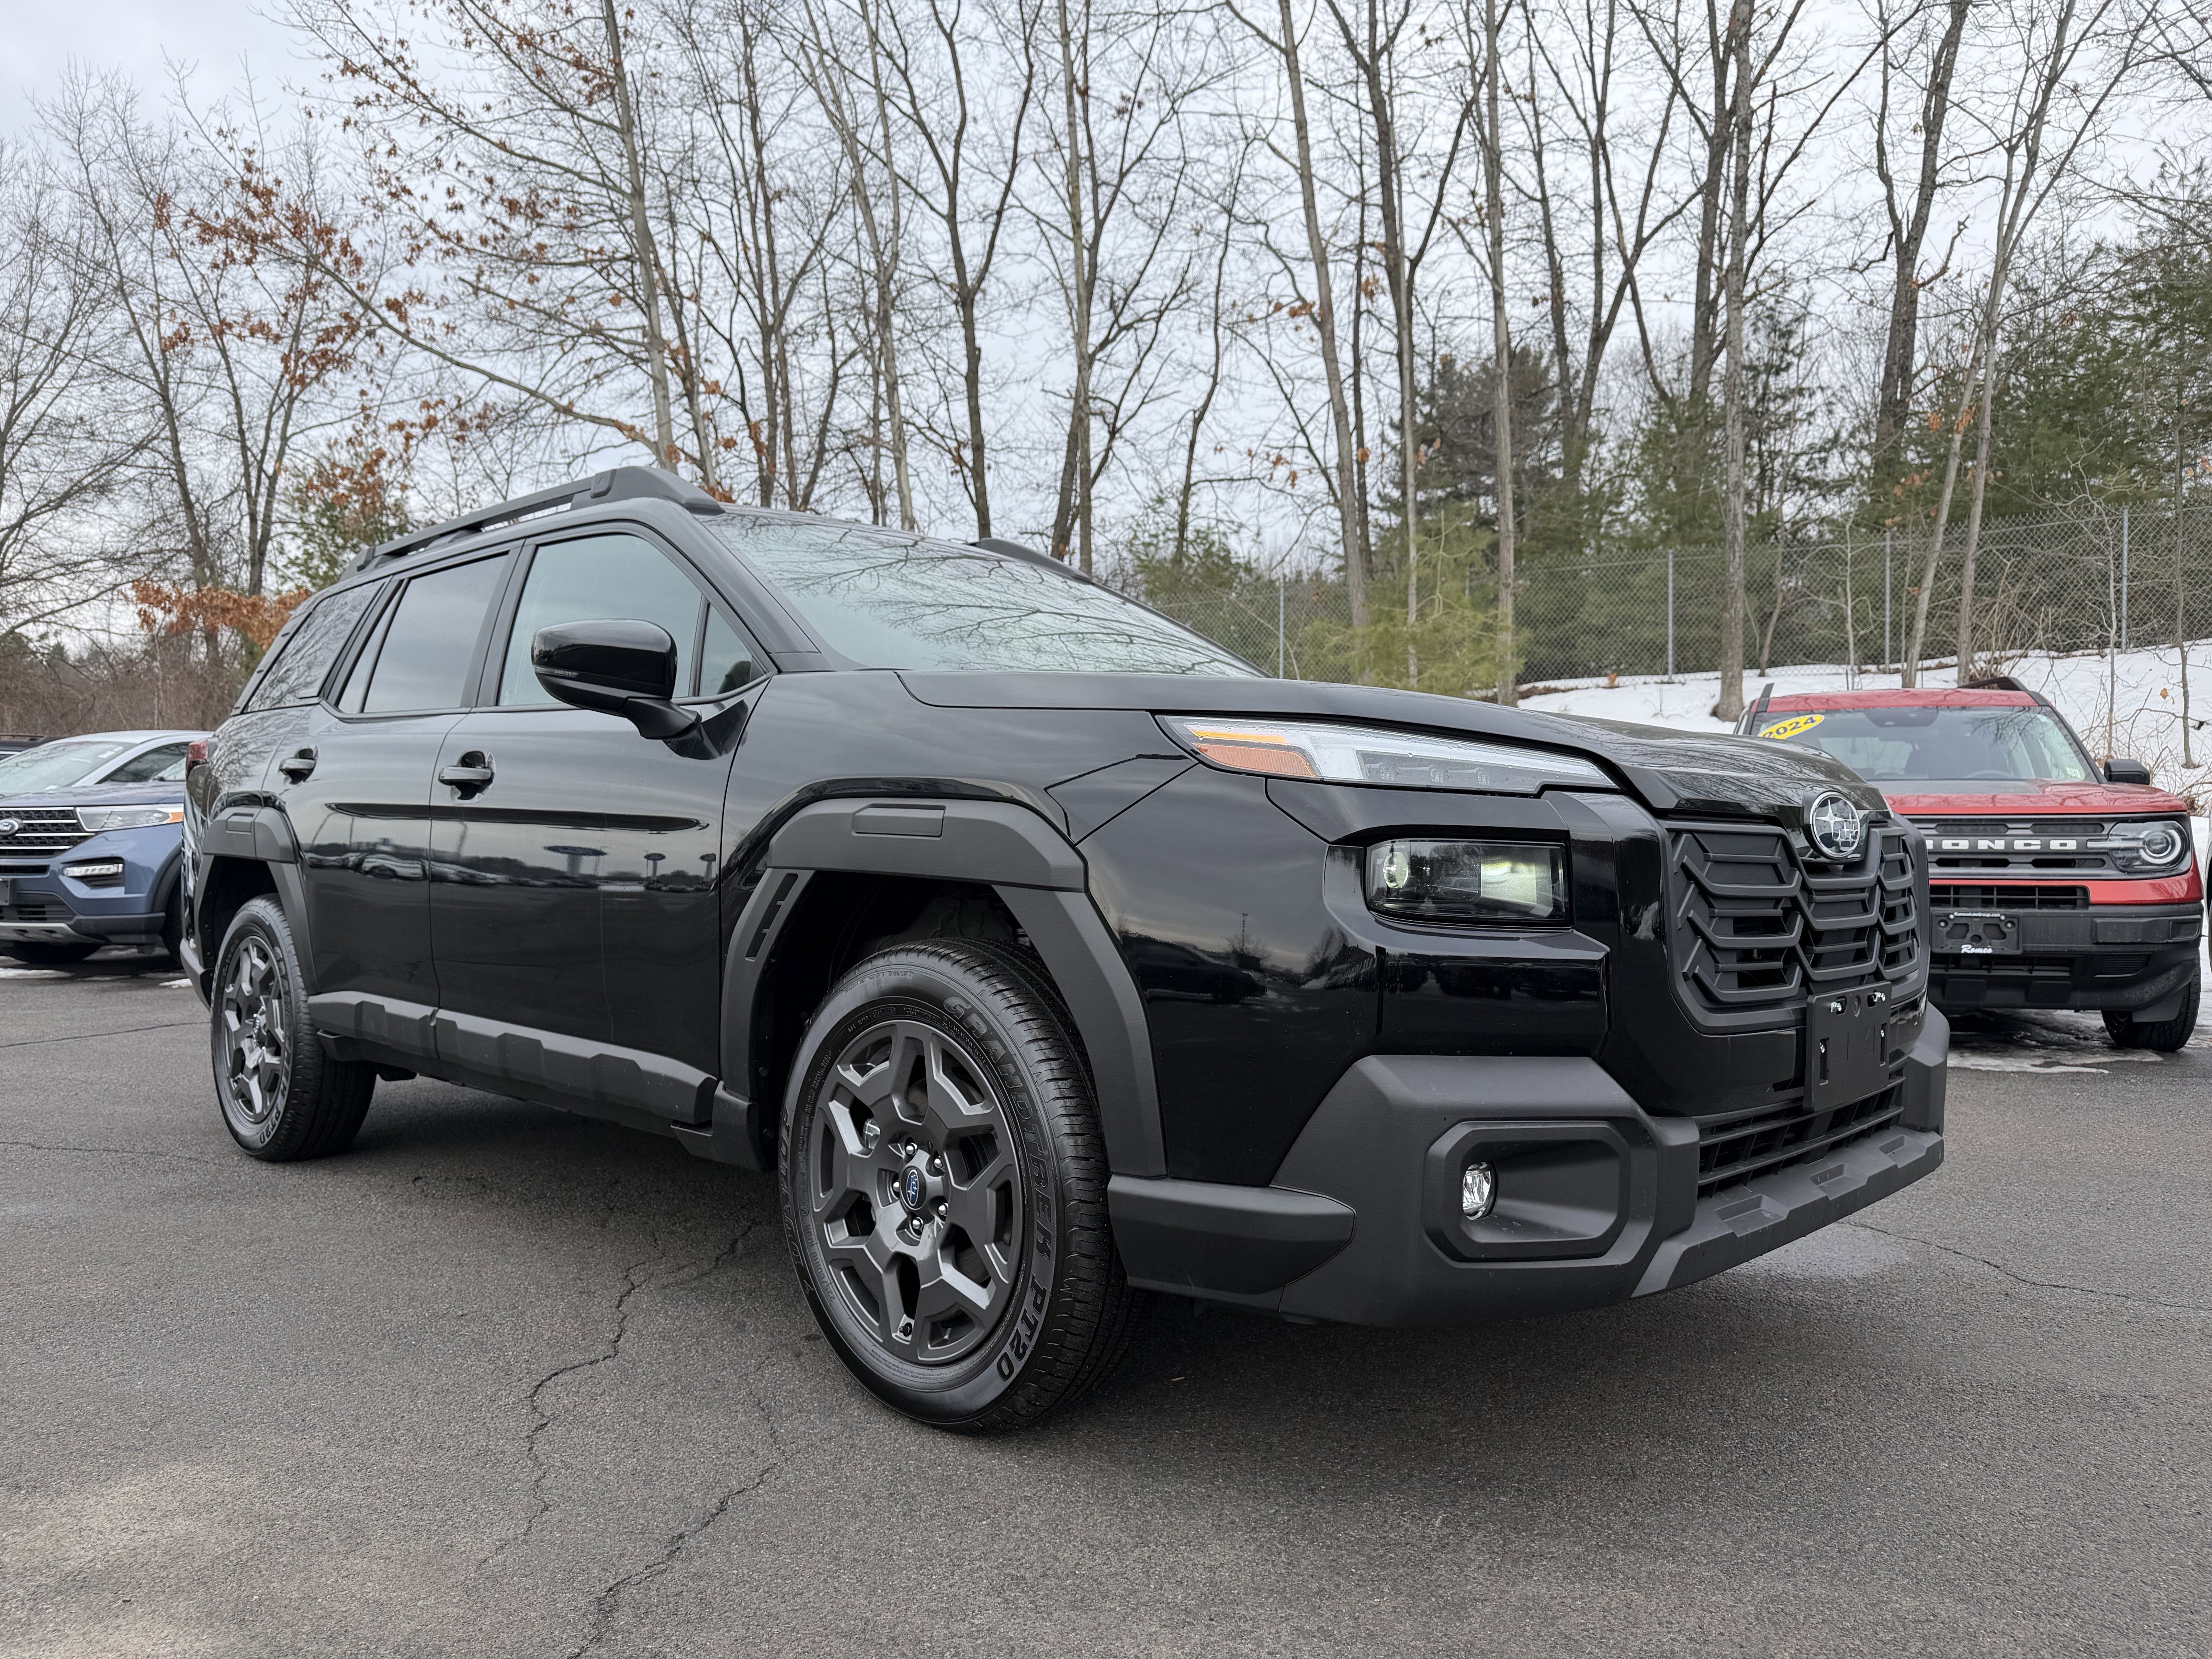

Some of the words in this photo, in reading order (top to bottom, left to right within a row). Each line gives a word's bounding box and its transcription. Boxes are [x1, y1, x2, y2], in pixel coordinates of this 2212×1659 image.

[1926, 839, 2077, 850] ONCO
[1961, 944, 1993, 954] Romeo
[943, 997, 1052, 1261] GRANDTREK
[996, 1273, 1047, 1381] PT20
